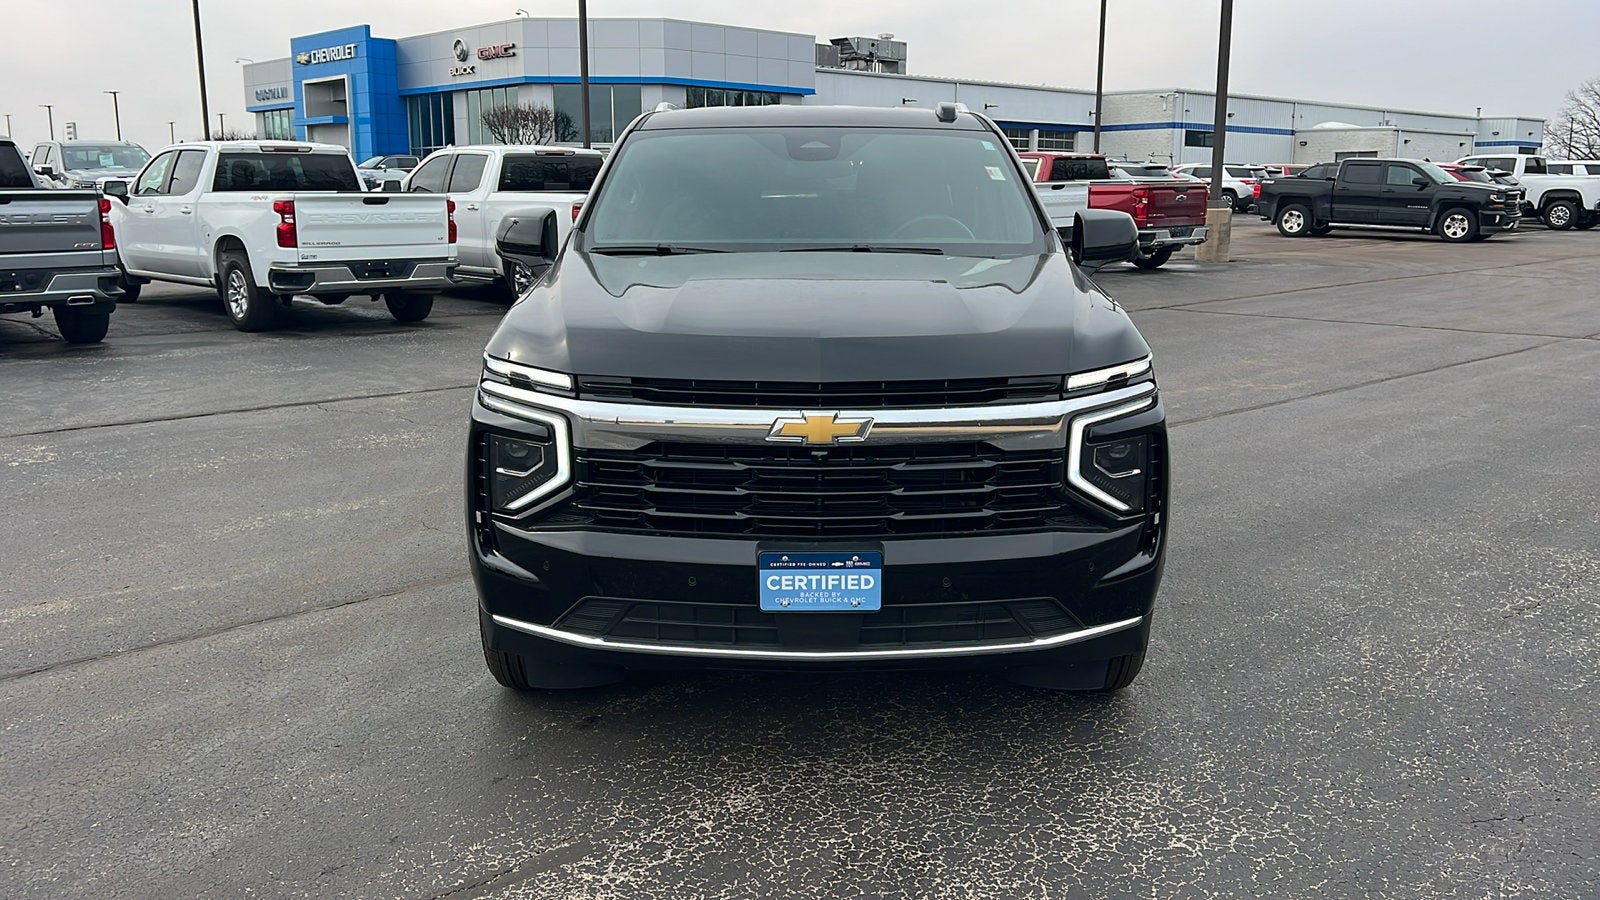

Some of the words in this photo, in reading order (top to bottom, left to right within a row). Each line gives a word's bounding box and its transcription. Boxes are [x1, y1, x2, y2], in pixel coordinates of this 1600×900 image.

[311, 43, 356, 64] CHEVROLET
[477, 43, 516, 61] GMC
[449, 66, 475, 77] BUICK
[766, 575, 875, 591] CERTIFIED
